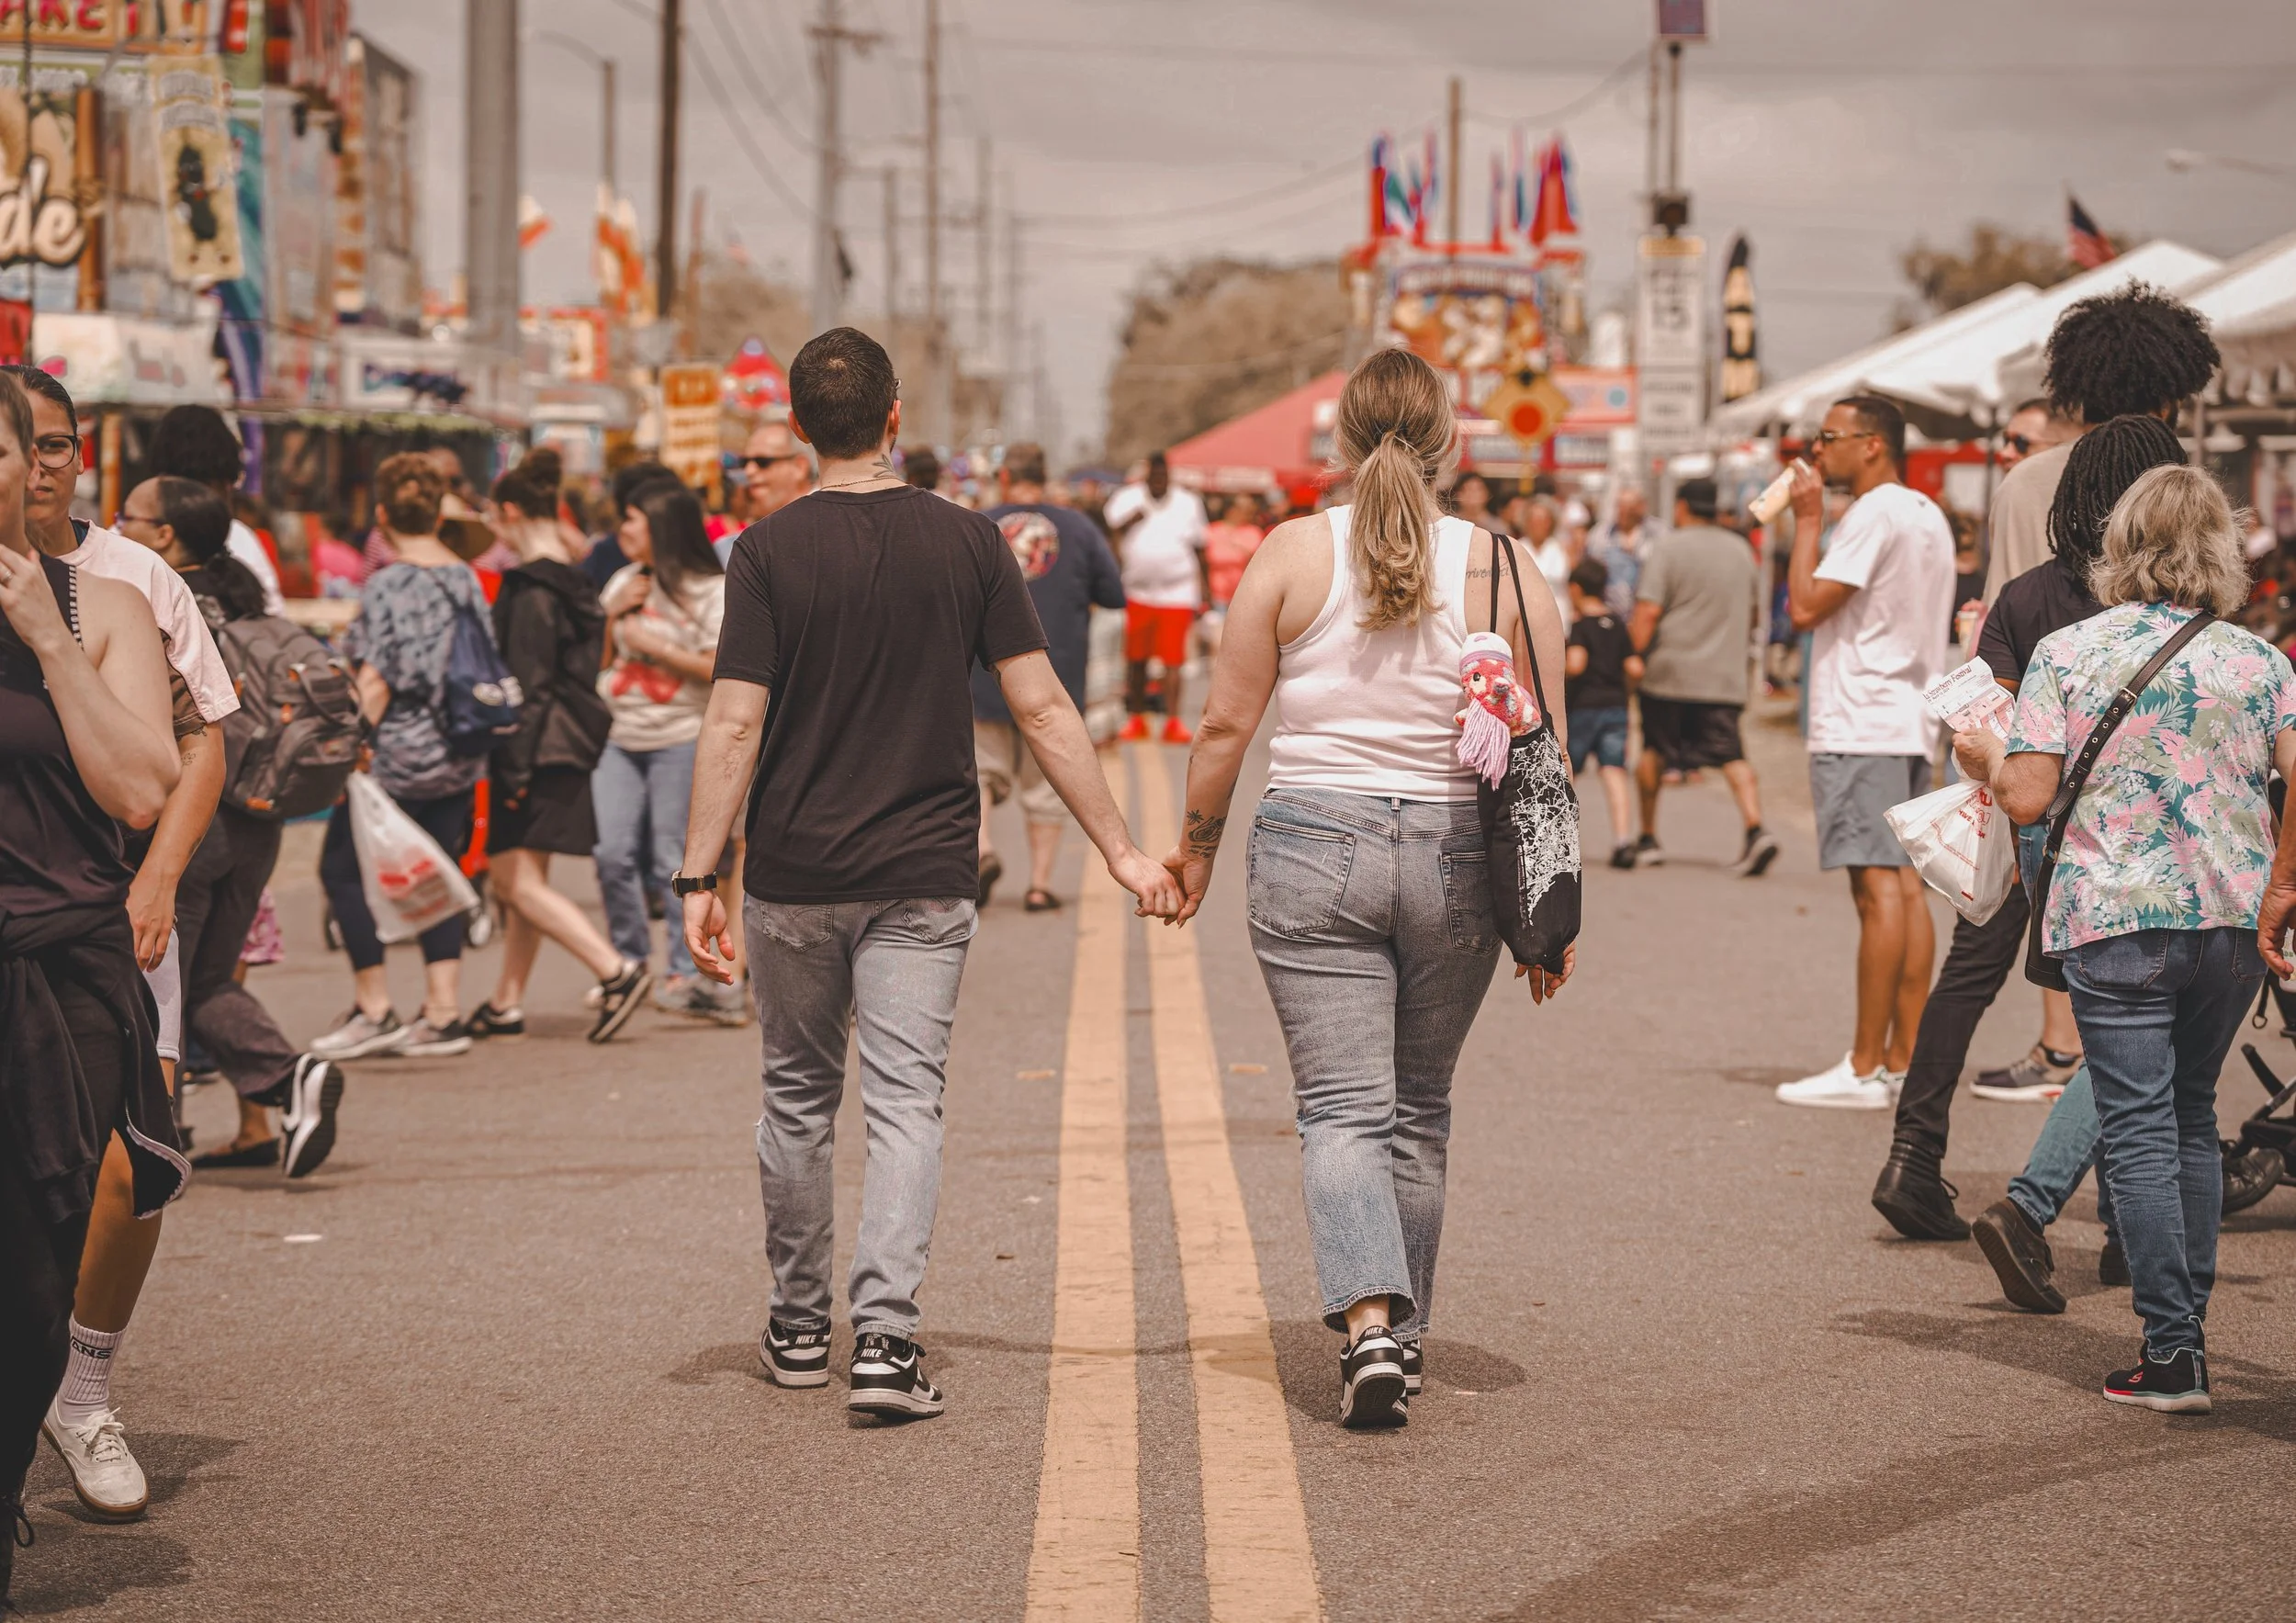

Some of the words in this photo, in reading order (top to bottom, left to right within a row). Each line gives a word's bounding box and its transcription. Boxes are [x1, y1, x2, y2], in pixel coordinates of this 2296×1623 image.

[1951, 665, 1972, 682] Festival
[1364, 1326, 1383, 1337] NIKE
[795, 1335, 816, 1345] NIKE
[71, 1336, 112, 1359] ANS
[861, 1347, 883, 1358] NIKE
